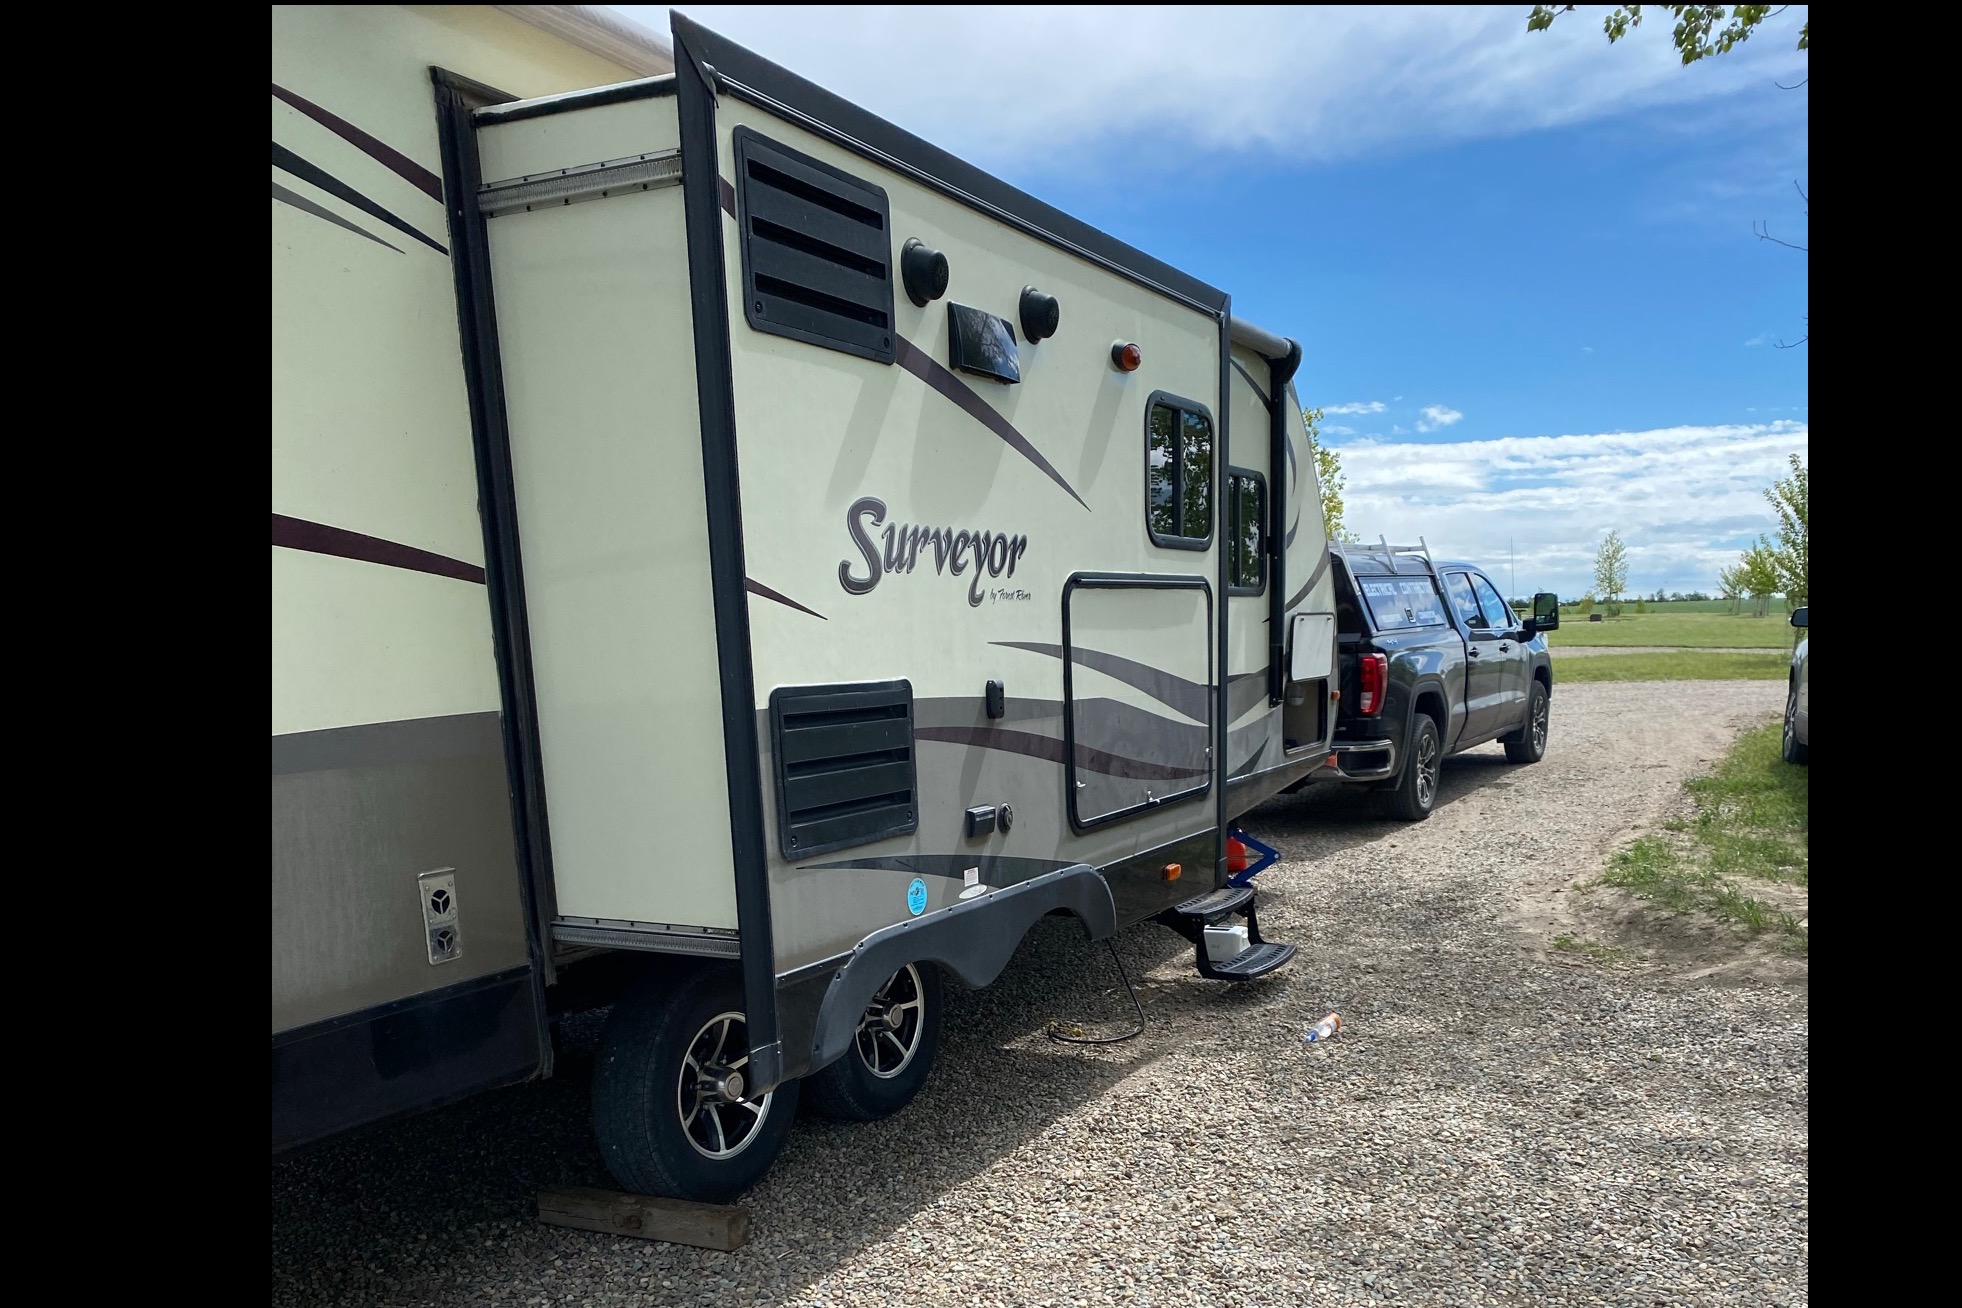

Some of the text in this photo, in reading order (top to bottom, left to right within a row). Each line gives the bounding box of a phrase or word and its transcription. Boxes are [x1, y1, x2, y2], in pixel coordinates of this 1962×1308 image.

[839, 496, 1027, 607] Surveyor
[989, 587, 1032, 605] by Forest River
